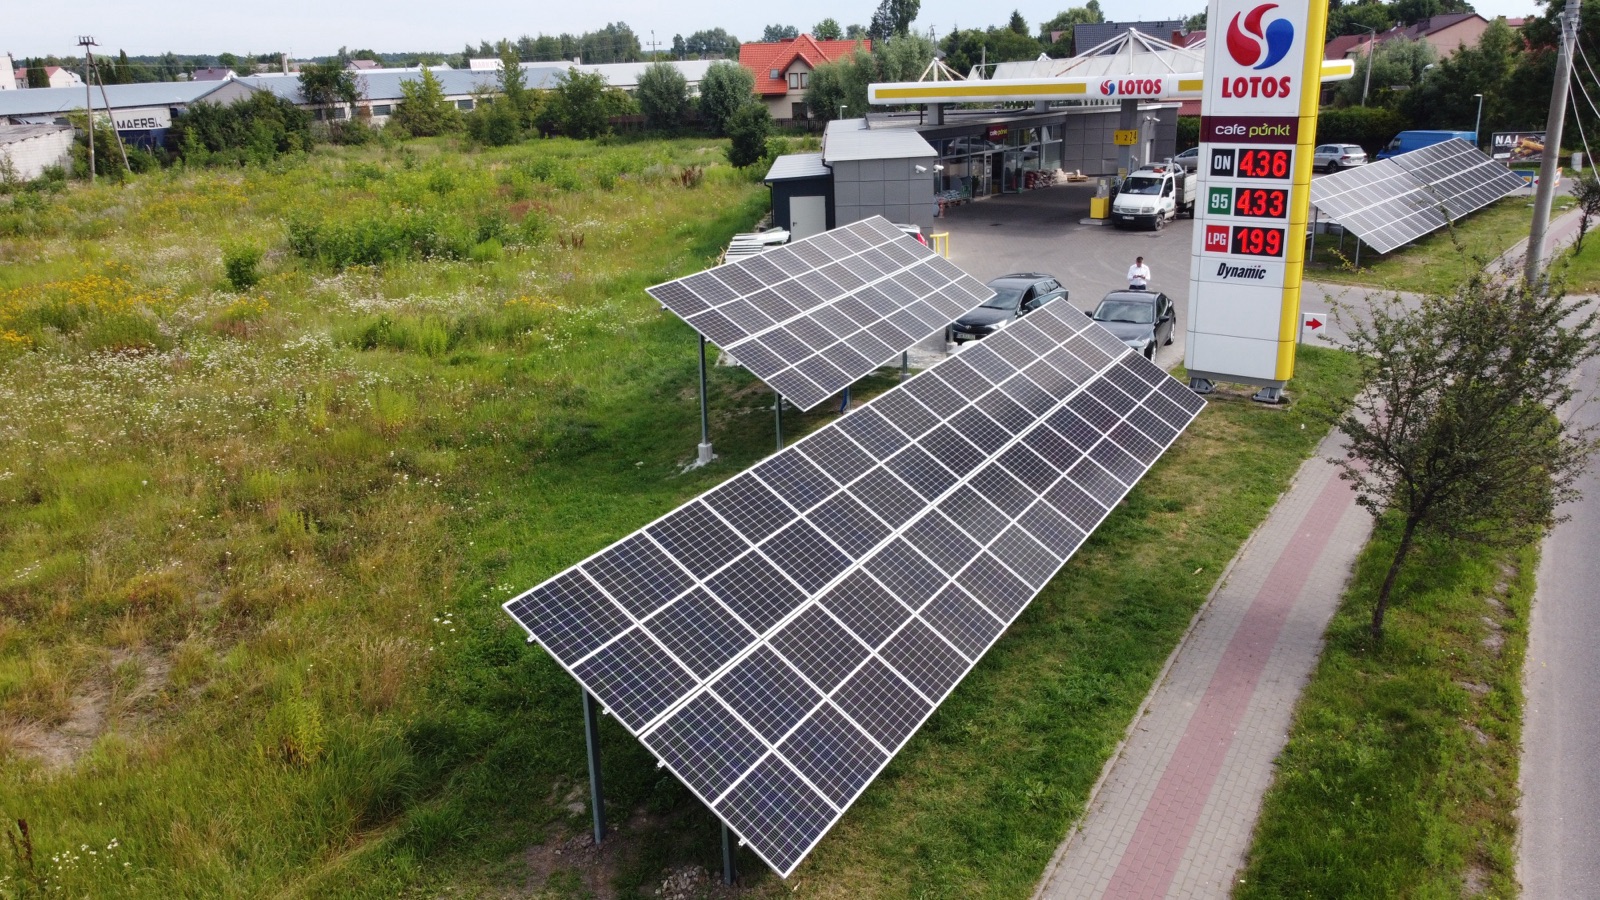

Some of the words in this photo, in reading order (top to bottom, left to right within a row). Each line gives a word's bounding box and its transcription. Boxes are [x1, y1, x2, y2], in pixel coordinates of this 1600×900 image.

[1118, 79, 1162, 95] LOTOS
[1221, 76, 1291, 98] LOTOS
[1215, 124, 1246, 135] cafe
[1495, 135, 1519, 145] NAJ
[1214, 155, 1231, 170] ON
[1211, 193, 1228, 209] 95
[1207, 232, 1226, 249] LPG
[1216, 262, 1267, 279] Dynamic
